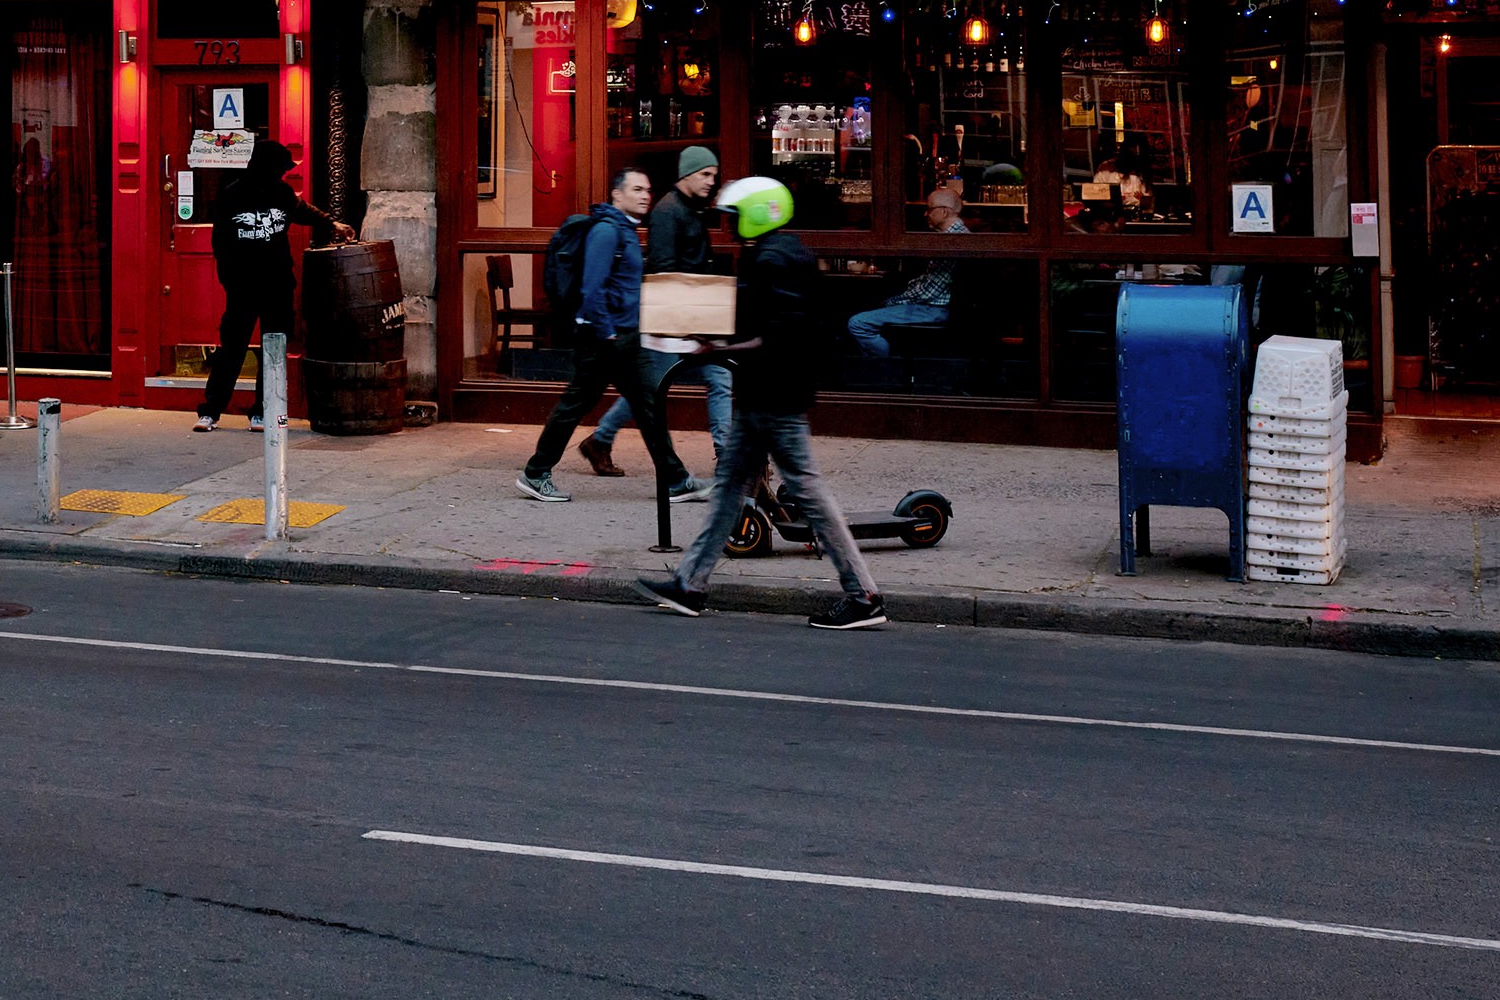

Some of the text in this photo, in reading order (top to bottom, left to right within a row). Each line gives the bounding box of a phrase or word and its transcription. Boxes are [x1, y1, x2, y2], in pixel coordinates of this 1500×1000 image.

[194, 41, 241, 67] 793
[218, 93, 239, 118] A
[1240, 191, 1266, 219] A
